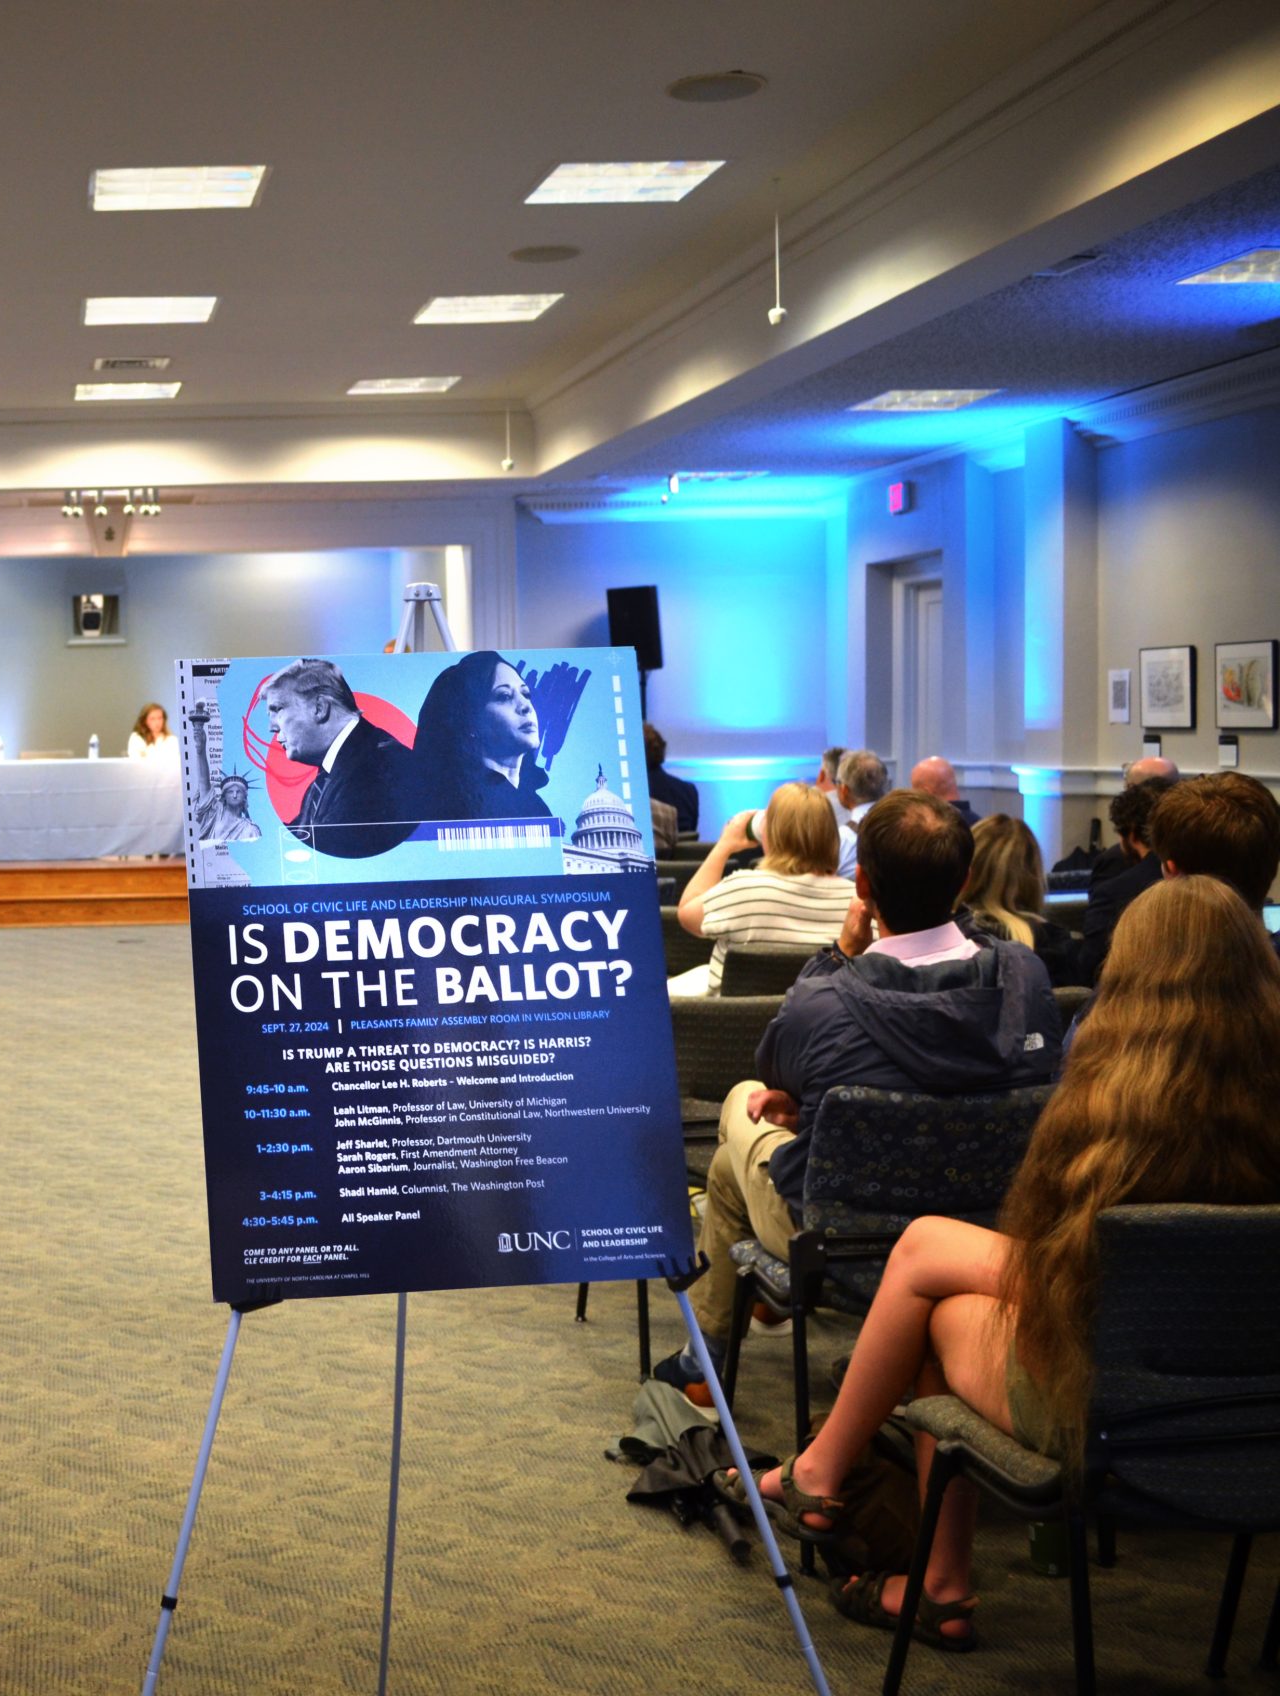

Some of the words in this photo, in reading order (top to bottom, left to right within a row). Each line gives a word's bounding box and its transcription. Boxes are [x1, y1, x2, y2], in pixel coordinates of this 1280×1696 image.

[242, 903, 291, 916] SCHOOL
[293, 902, 309, 914] OF
[311, 901, 343, 913] CIVIC
[345, 900, 368, 912] LIFE
[370, 899, 397, 911] AND
[399, 896, 468, 910] LEADERSHIP
[470, 894, 538, 907] INAUGURAL
[540, 891, 611, 904] SYMPOSIUM
[228, 923, 268, 965] IS
[283, 909, 628, 963] DEMOCRACY
[230, 973, 302, 1013] ON
[321, 968, 418, 1009] THE
[436, 960, 632, 1004] BALLOT?
[261, 1023, 287, 1034] SEPT.
[289, 1022, 302, 1033] 27,
[304, 1021, 329, 1032] 2024
[350, 1018, 404, 1030] PLEASANTS
[405, 1017, 439, 1027] FAMILY
[441, 1015, 488, 1026] ASSEMBLY
[490, 1014, 520, 1024] ROOM
[522, 1013, 532, 1022] IN
[534, 1012, 571, 1021] WILSON
[573, 1010, 610, 1020] LIBRARY
[282, 1049, 295, 1061] IS
[296, 1047, 344, 1060] TRUMP
[347, 1046, 357, 1058] A
[358, 1044, 410, 1057] THREAT
[412, 1043, 431, 1055] TO
[434, 1039, 520, 1054] DEMOCRACY?
[523, 1038, 536, 1050] IS
[538, 1036, 591, 1049] HARRIS?
[325, 1061, 351, 1074] ARE
[352, 1059, 396, 1072] THOSE
[399, 1056, 474, 1072] QUESTIONS
[476, 1052, 556, 1067] MISGUIDED?
[287, 1084, 309, 1093] a.m.
[331, 1080, 381, 1092] Chancellor
[381, 1079, 398, 1090] Lee
[399, 1078, 411, 1089] H.
[411, 1077, 448, 1088] Roberts
[456, 1075, 499, 1086] Welcome
[500, 1074, 517, 1084] and
[518, 1072, 574, 1083] Introduction
[289, 1109, 311, 1118] a.m.
[333, 1105, 356, 1116] Leah
[356, 1104, 391, 1115] Litman,
[392, 1102, 434, 1113] Professor
[436, 1101, 445, 1111] of
[447, 1101, 467, 1110] Law,
[468, 1099, 514, 1109] University
[515, 1097, 524, 1107] of
[526, 1097, 567, 1107] Michigan
[334, 1117, 357, 1128] John
[357, 1115, 404, 1127] McGinnis,
[405, 1114, 447, 1124] Professor
[448, 1113, 457, 1122] in
[459, 1110, 521, 1122] Constitutional
[523, 1110, 543, 1119] Law,
[544, 1108, 605, 1117] Northwestern
[606, 1105, 650, 1115] University
[291, 1143, 314, 1154] p.m.
[336, 1139, 353, 1150] Jeff
[354, 1138, 390, 1150] Sharlet,
[391, 1137, 435, 1149] Professor,
[437, 1134, 486, 1145] Dartmouth
[487, 1132, 532, 1143] University
[336, 1151, 364, 1163] Sarah
[364, 1151, 399, 1163] Rogers,
[400, 1149, 420, 1159] First
[422, 1147, 477, 1158] Amendment
[479, 1146, 518, 1158] Attorney
[337, 1164, 366, 1175] Aaron
[367, 1162, 411, 1174] Sibarium,
[413, 1160, 458, 1171] Journalist,
[459, 1158, 514, 1169] Washington
[515, 1156, 534, 1166] Free
[536, 1156, 568, 1165] Beacon
[294, 1191, 317, 1201] p.m.
[339, 1187, 365, 1198] Shadi
[366, 1185, 400, 1196] Hamid,
[401, 1184, 449, 1195] Columnist,
[451, 1182, 468, 1192] The
[470, 1181, 524, 1191] Washington
[525, 1179, 545, 1188] Post
[296, 1216, 319, 1226] p.m.
[341, 1213, 355, 1223] All
[356, 1211, 393, 1224] Speaker
[395, 1210, 421, 1220] Panel
[581, 1228, 613, 1237] SCHOOL
[613, 1227, 624, 1235] OF
[625, 1226, 646, 1235] CIVIC
[647, 1225, 663, 1233] LIFE
[243, 1248, 265, 1256] COME
[278, 1247, 294, 1255] ANY
[295, 1246, 318, 1254] PANEL
[320, 1245, 331, 1253] OR
[343, 1244, 359, 1252] ALL.
[512, 1230, 571, 1252] UNC
[582, 1240, 600, 1248] AND
[601, 1237, 648, 1247] LEADERSHIP
[244, 1257, 258, 1265] CLE
[259, 1256, 285, 1264] CREDIT
[286, 1255, 301, 1263] FOR
[302, 1254, 322, 1264] EACH
[323, 1253, 349, 1261] PANEL.
